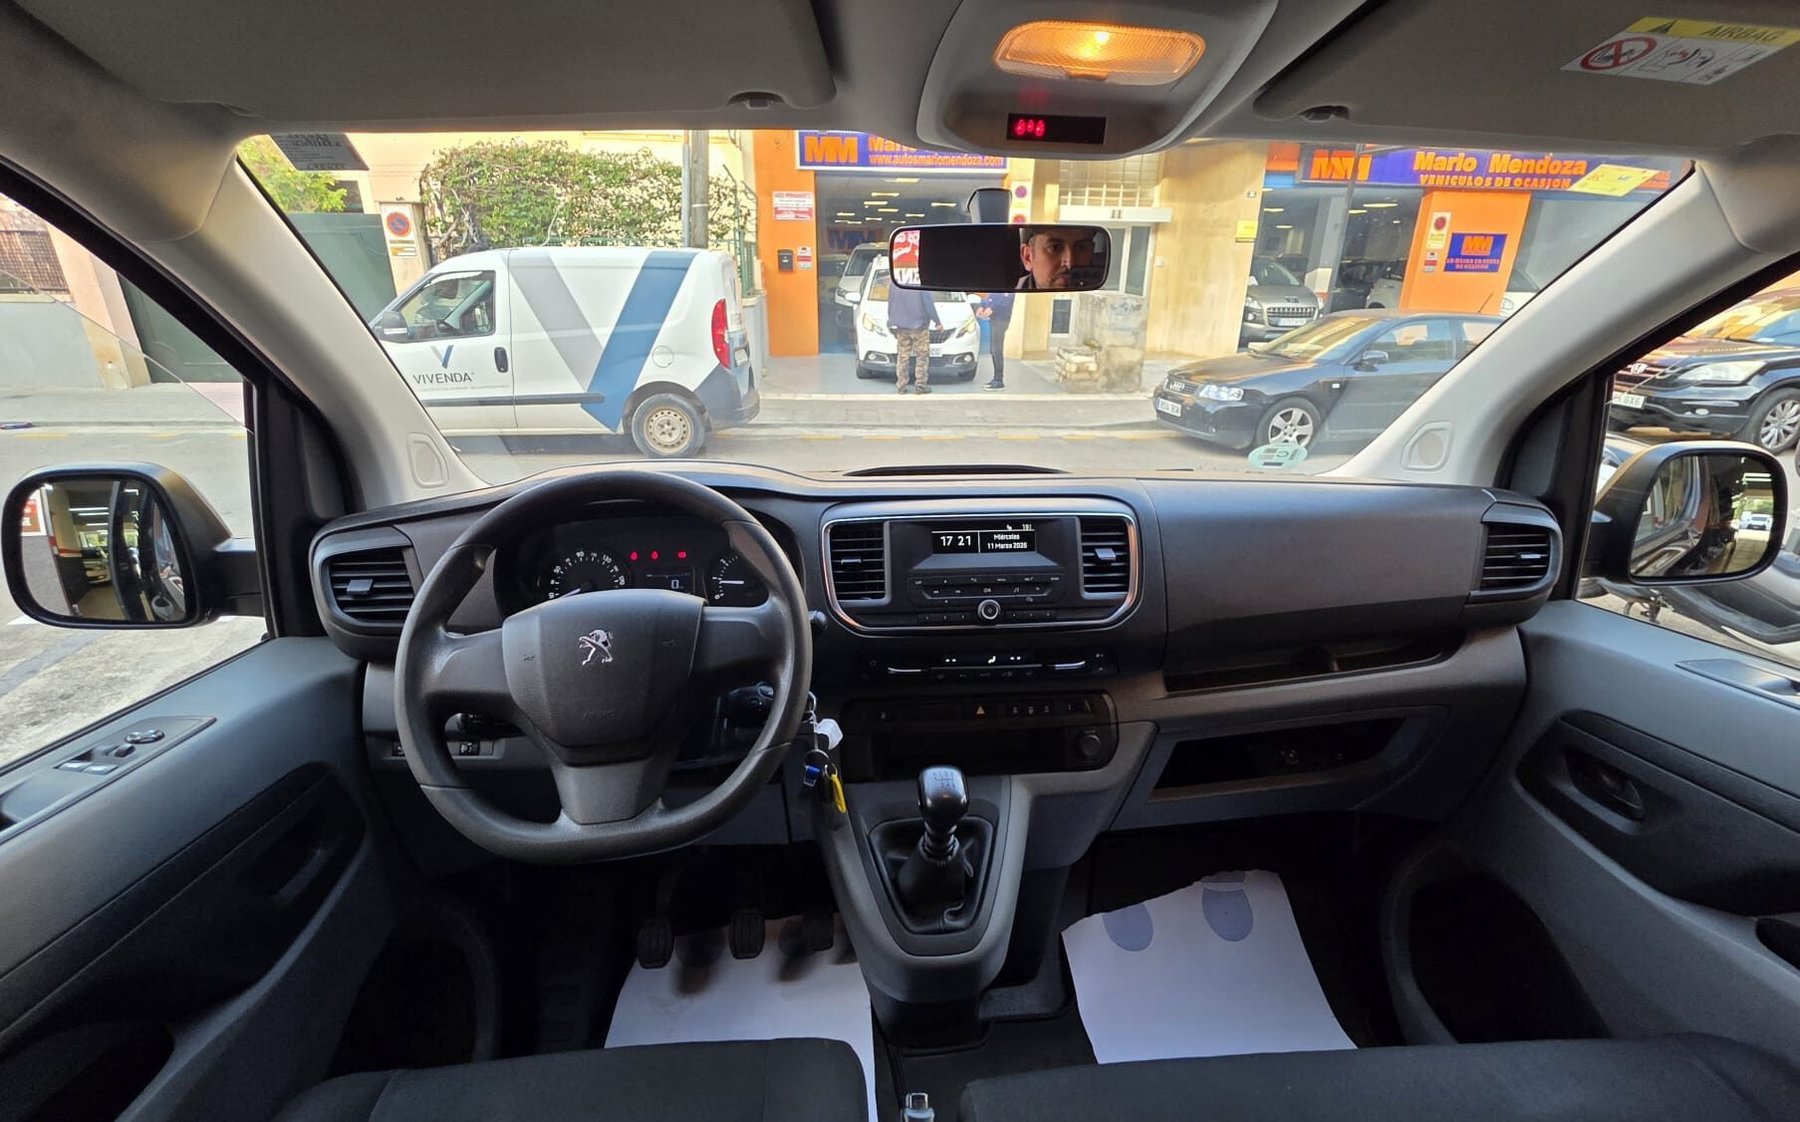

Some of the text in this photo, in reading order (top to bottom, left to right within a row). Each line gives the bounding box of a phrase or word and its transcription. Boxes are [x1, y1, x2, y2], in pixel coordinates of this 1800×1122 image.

[1701, 25, 1783, 41] AIRBAG
[804, 136, 858, 163] MM
[1413, 151, 1588, 176] Mario Mendoza
[1494, 176, 1511, 187] DE
[412, 372, 472, 384] VIVENDA
[940, 535, 972, 547] 17 21
